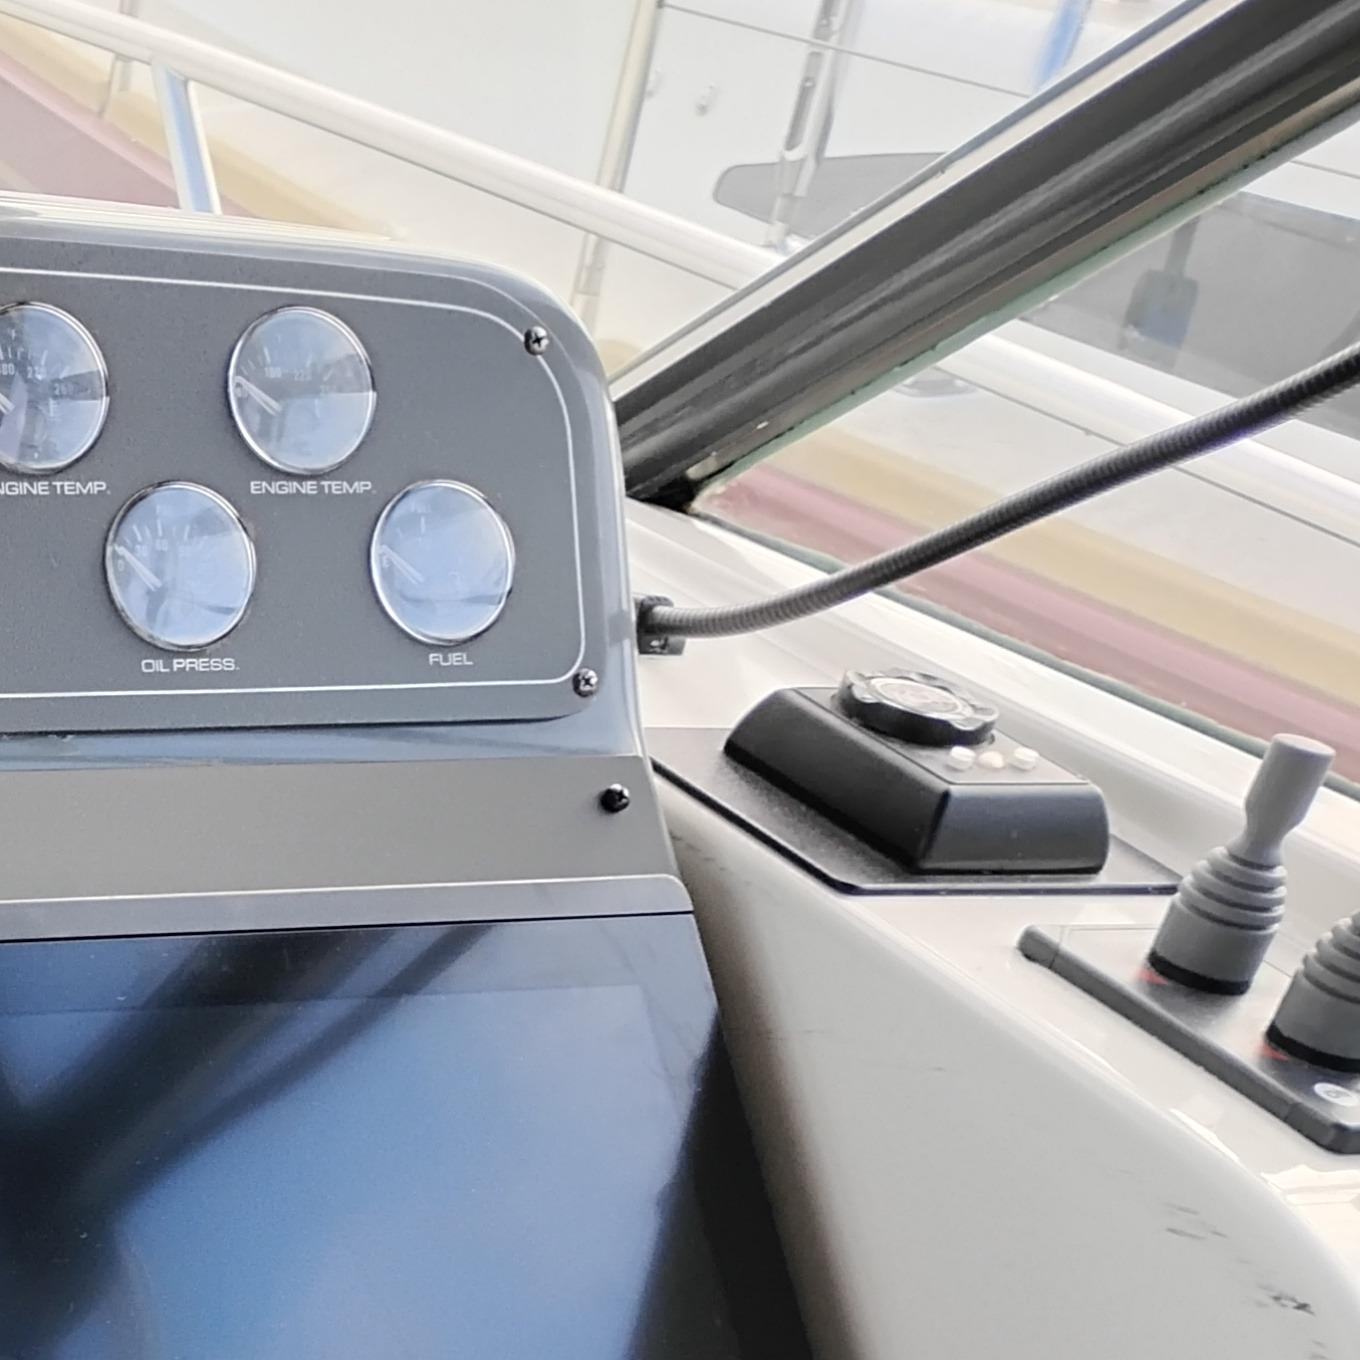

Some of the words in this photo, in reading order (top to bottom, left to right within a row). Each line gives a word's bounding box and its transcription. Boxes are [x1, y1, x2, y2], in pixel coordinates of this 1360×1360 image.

[250, 481, 318, 494] ENGINE
[141, 659, 170, 672] OIL
[429, 653, 474, 666] FUEL
